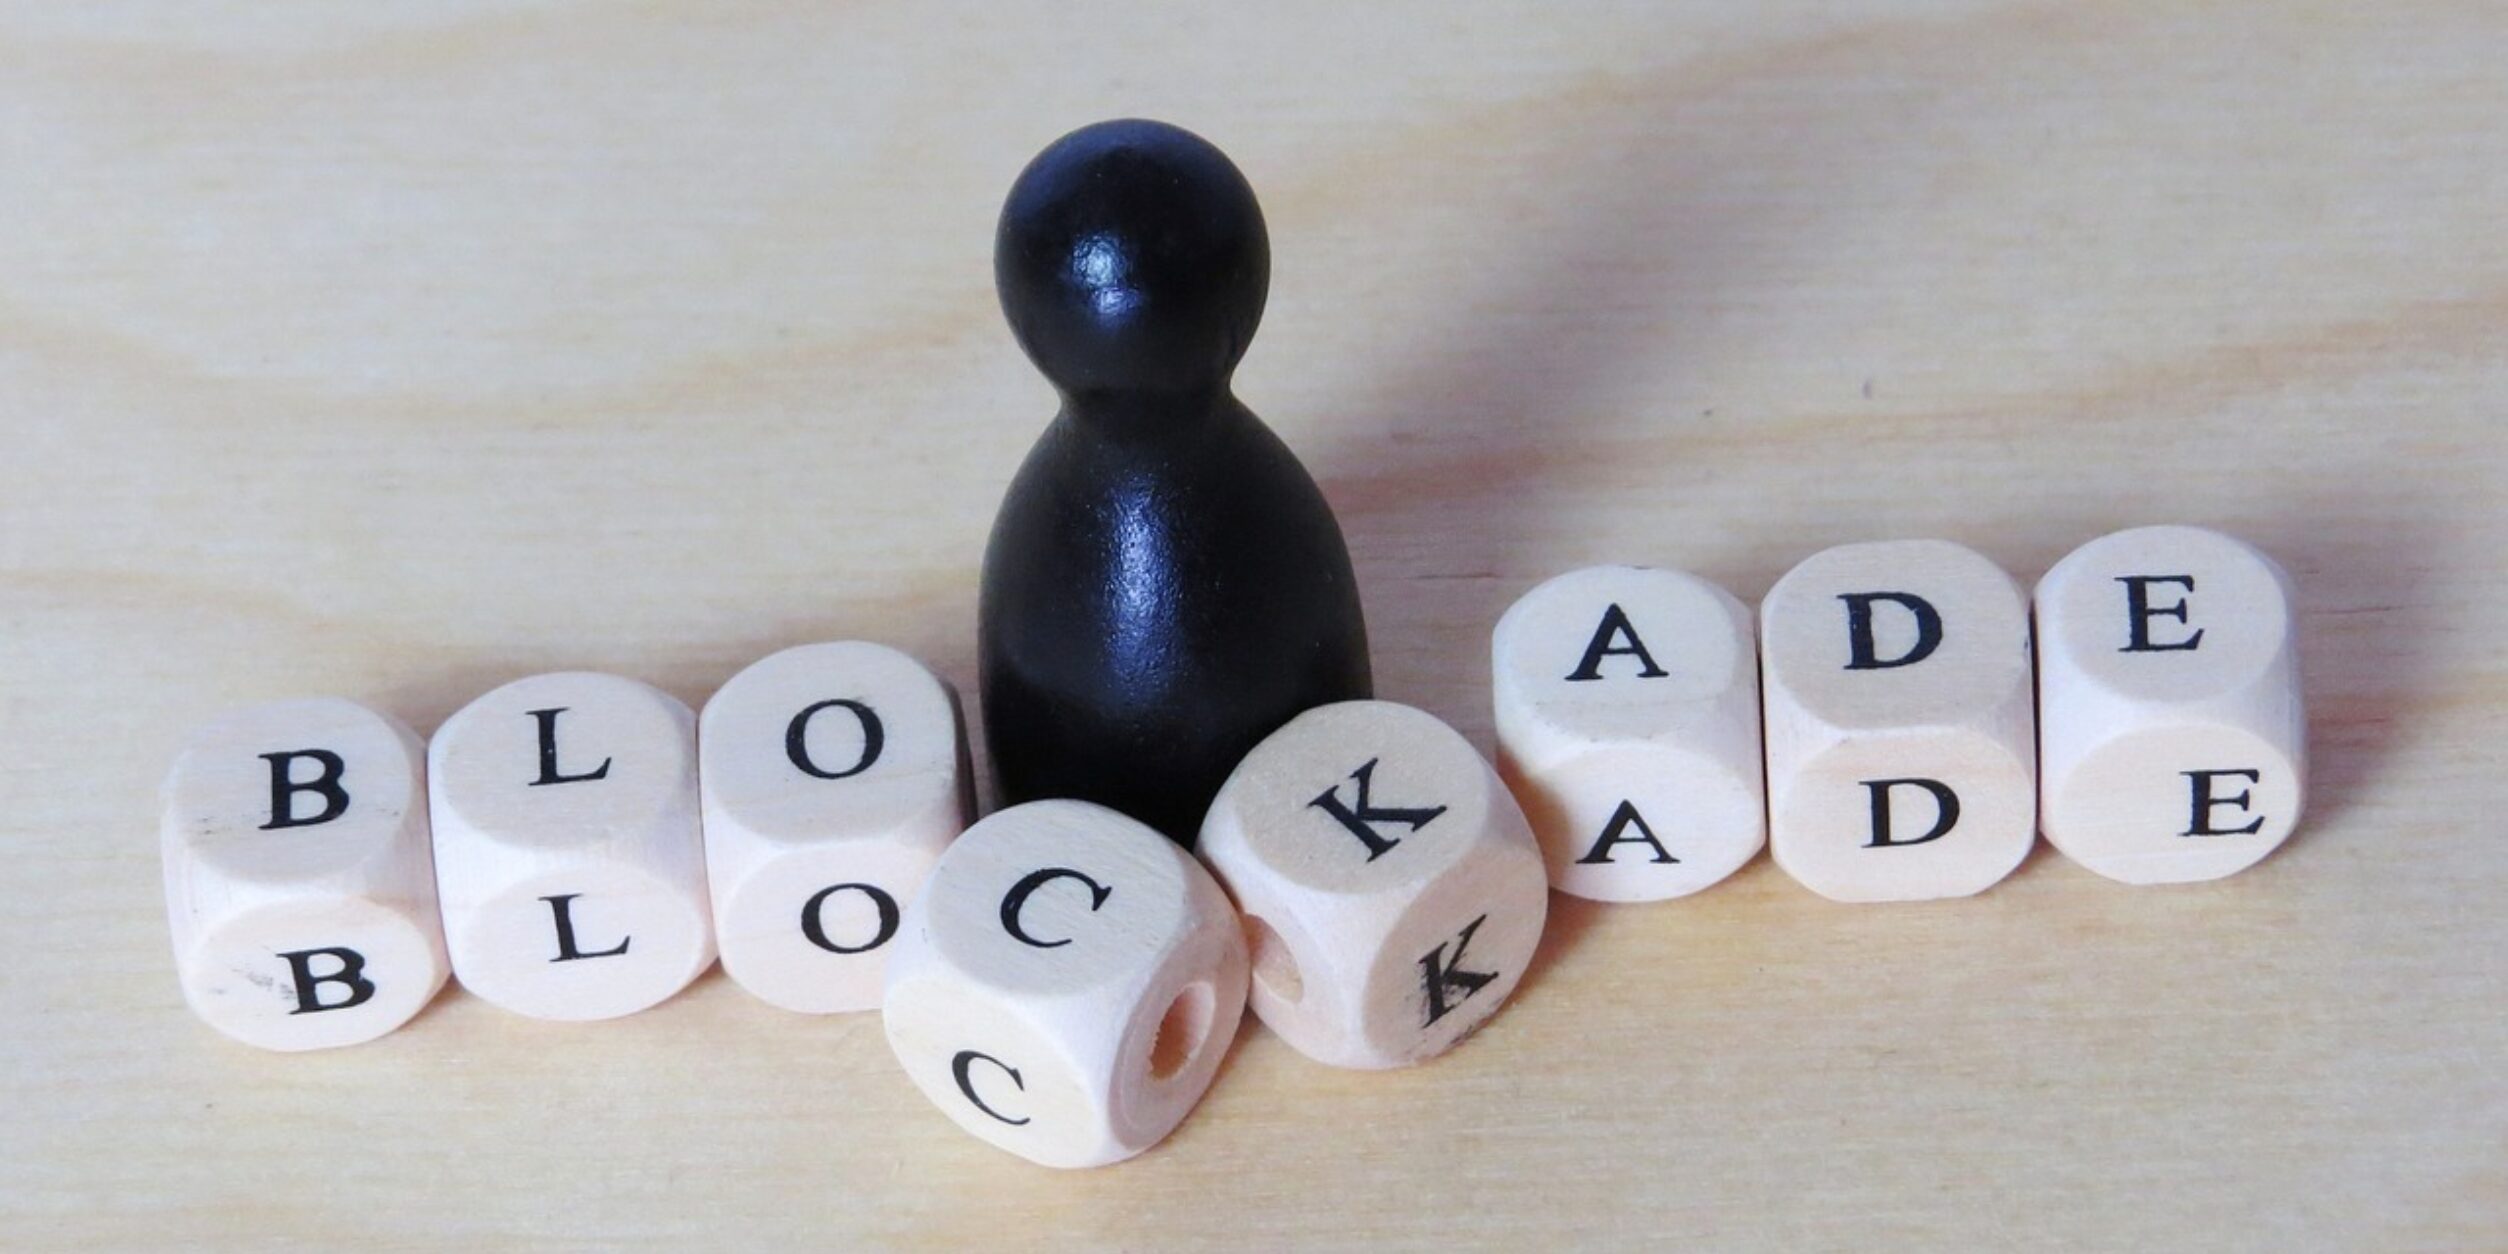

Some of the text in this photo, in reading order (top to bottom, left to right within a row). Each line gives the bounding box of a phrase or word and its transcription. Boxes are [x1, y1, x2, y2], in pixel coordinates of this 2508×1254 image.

[1564, 603, 1669, 682] A
[1837, 591, 1943, 671] D
[2114, 575, 2205, 653] E
[526, 707, 612, 786] L
[785, 698, 885, 780] O
[258, 749, 350, 831] B
[1307, 757, 1447, 863] K
[1859, 778, 1960, 848] D
[2179, 769, 2265, 837] E
[1574, 800, 1680, 865] A
[539, 893, 631, 962] L
[801, 883, 900, 954] O
[1000, 867, 1111, 949] C
[277, 946, 375, 1015] B
[1418, 913, 1500, 1029] K
[951, 1050, 1031, 1127] C
